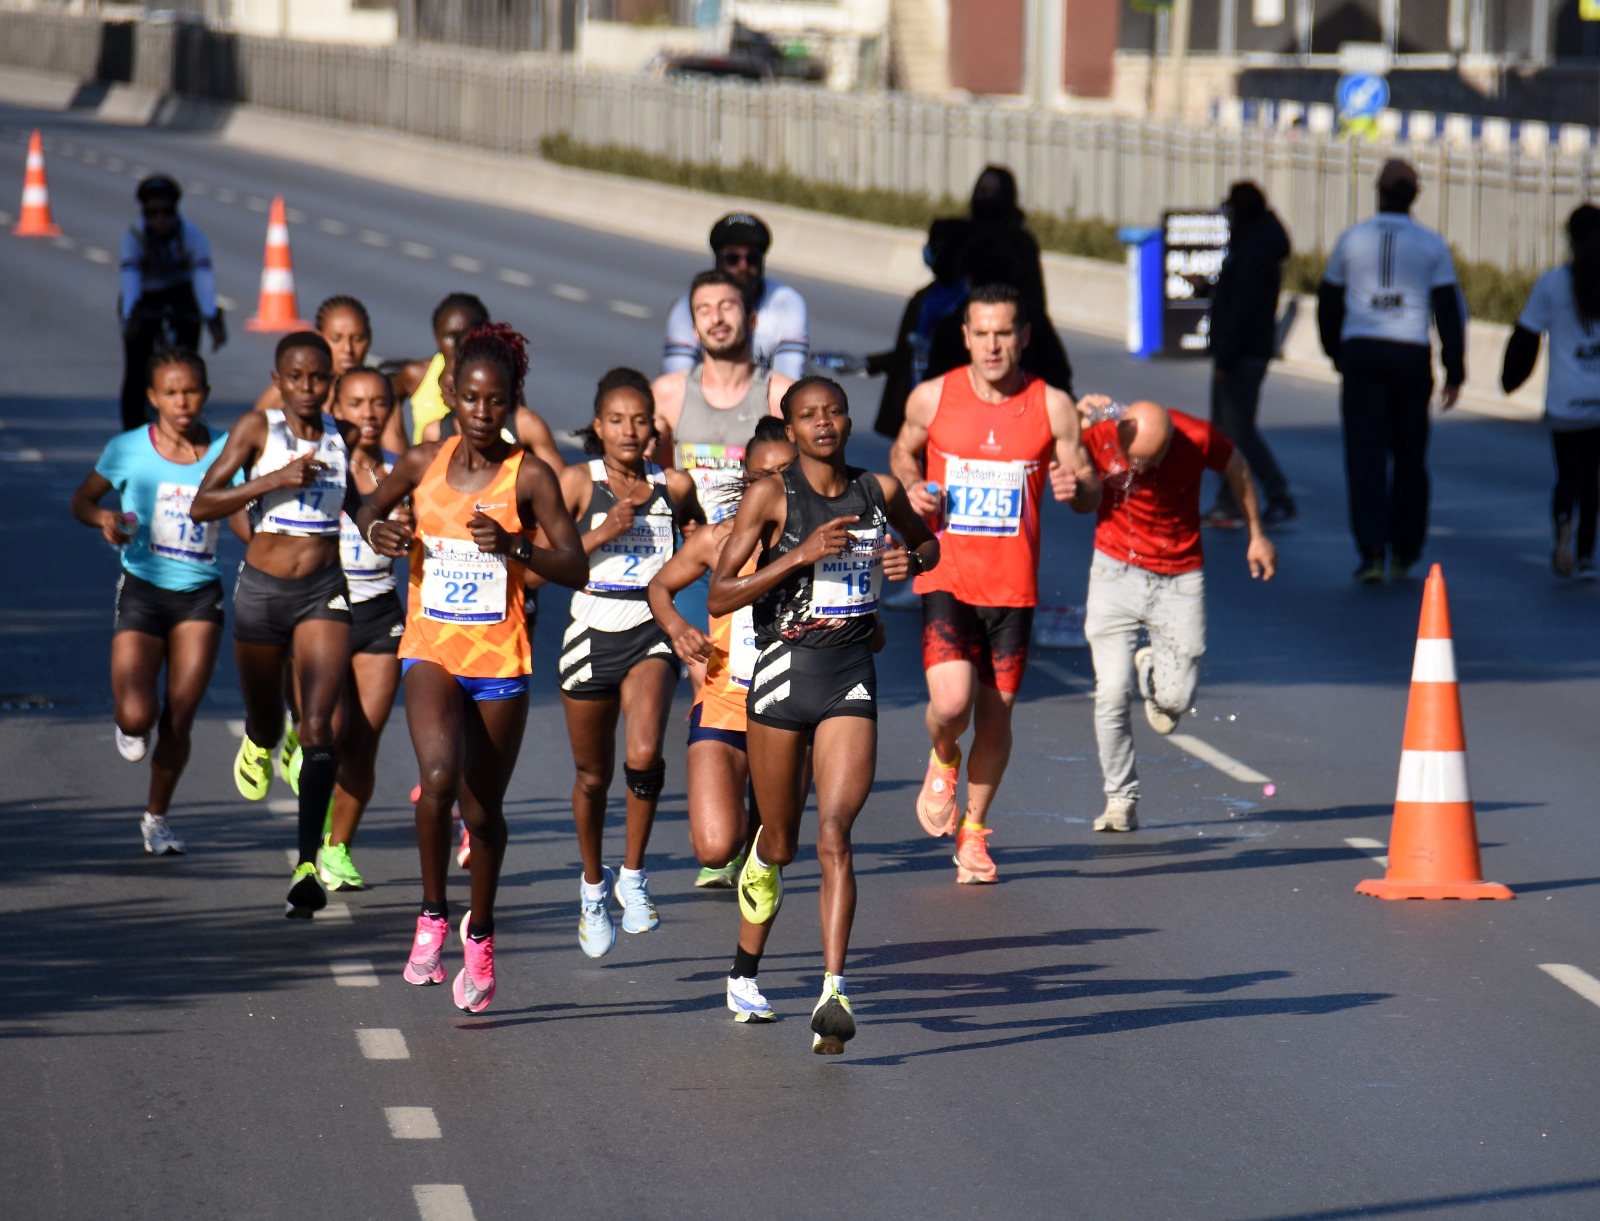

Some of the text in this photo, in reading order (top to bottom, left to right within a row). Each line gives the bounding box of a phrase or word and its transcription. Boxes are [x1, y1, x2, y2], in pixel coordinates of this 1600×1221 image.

[295, 491, 324, 512] 17
[955, 487, 1012, 517] 1245
[178, 523, 205, 544] 13
[351, 544, 361, 561] 1
[601, 544, 664, 554] GELETU
[433, 568, 493, 580] JUDITH
[623, 555, 640, 577] 2
[445, 581, 478, 604] 22
[842, 572, 871, 596] 16
